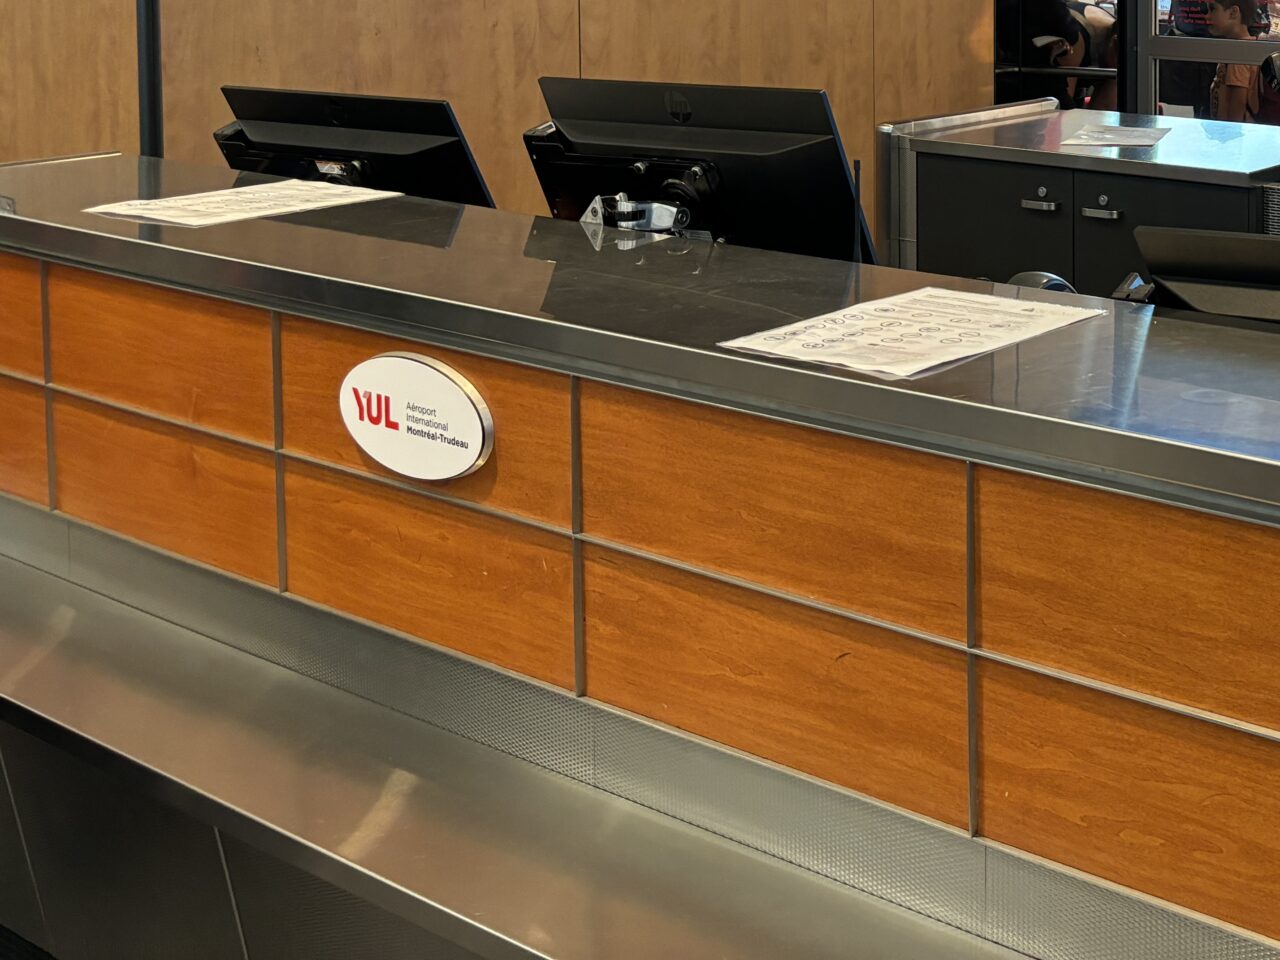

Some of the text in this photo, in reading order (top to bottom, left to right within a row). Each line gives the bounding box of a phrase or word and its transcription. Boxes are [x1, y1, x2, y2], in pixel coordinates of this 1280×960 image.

[352, 386, 400, 431] YUL
[406, 402, 436, 418] Aéroport
[406, 426, 469, 450] Montréal-Trudeau
